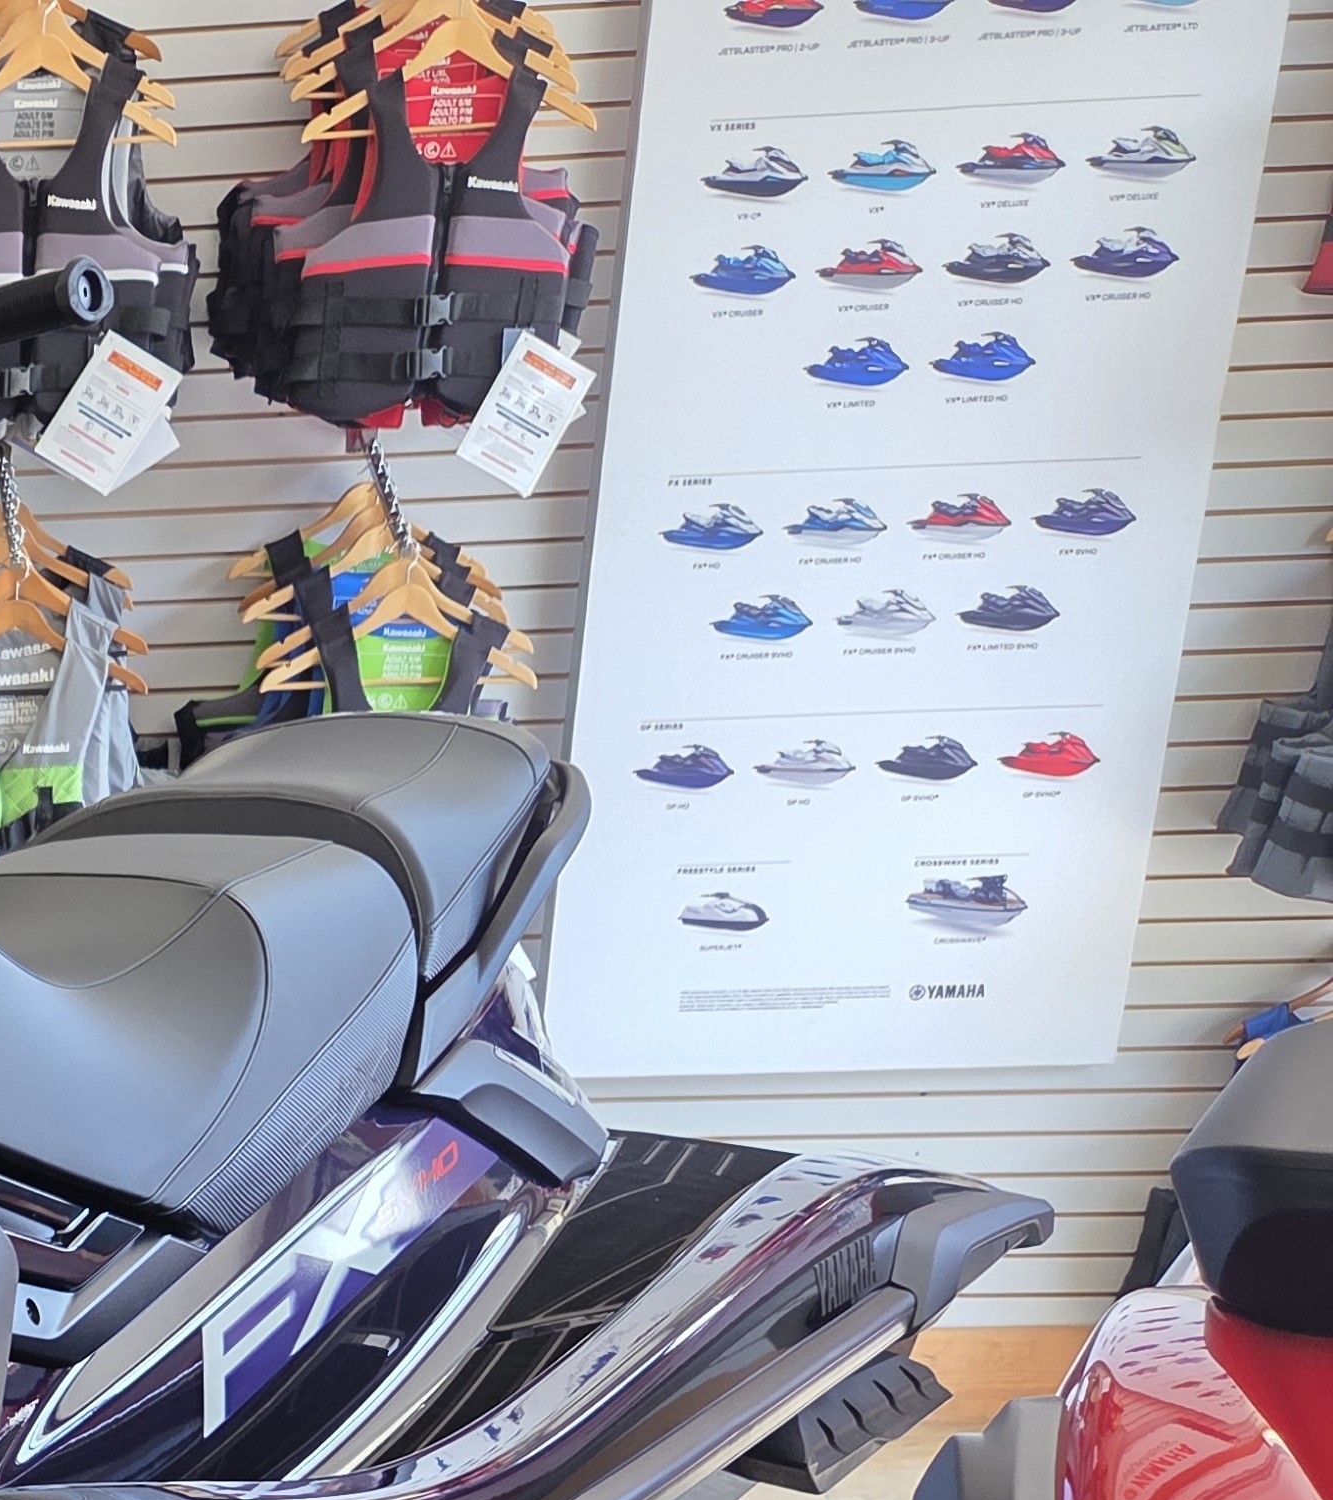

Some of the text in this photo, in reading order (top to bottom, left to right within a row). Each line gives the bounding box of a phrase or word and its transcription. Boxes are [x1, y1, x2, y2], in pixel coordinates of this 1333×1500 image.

[1183, 21, 1199, 30] LTD
[1037, 29, 1053, 38] PRO
[906, 36, 923, 45] PRO
[776, 44, 793, 53] PRO
[430, 85, 477, 96] Kawasaki
[14, 98, 58, 109] Kawasaki
[710, 122, 756, 132] VX SERIES
[467, 175, 519, 193] Kawasaki
[1126, 192, 1159, 202] DELUXE
[47, 194, 97, 211] Kawasaki
[997, 199, 1029, 209] DELUXE
[1102, 292, 1137, 302] CRUISER
[974, 298, 1009, 307] CRUISER
[854, 303, 889, 313] CRUISER
[728, 309, 763, 318] CRUISER
[843, 399, 875, 409] LIMITED
[961, 394, 994, 404] LIMITED
[682, 478, 712, 486] SERIES
[938, 552, 972, 561] CRUISER
[982, 642, 1015, 652] LIMITED
[654, 722, 683, 731] SERIES
[23, 741, 70, 754] Kawasaki
[914, 858, 999, 867] CROSSWAVE SERIES
[727, 866, 756, 874] SERIES
[928, 984, 985, 999] YAMAHA
[813, 1232, 877, 1315] YAMAHA
[202, 1143, 416, 1438] FX
